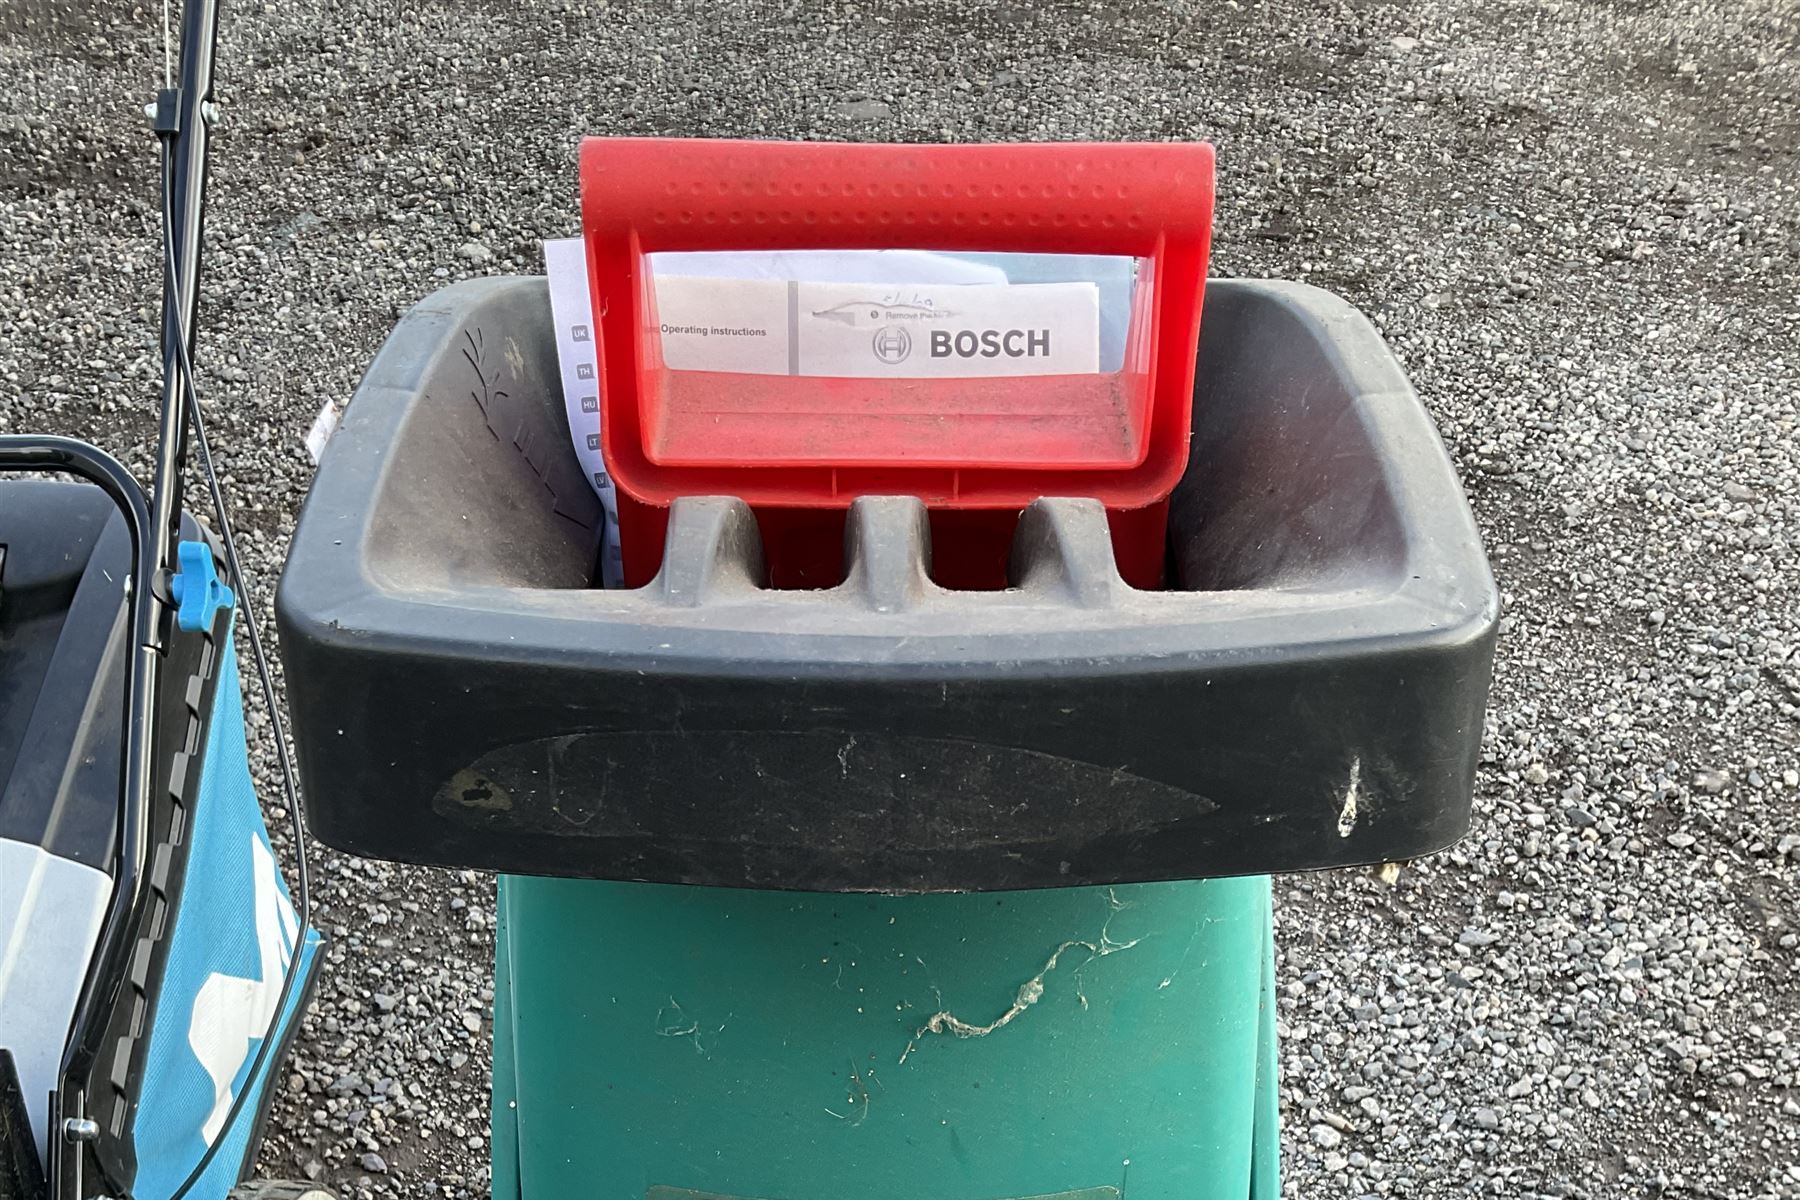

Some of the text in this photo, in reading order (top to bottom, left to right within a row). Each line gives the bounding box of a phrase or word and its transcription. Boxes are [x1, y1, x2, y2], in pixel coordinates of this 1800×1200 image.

[661, 324, 708, 336] Operating
[711, 326, 767, 337] instructions
[930, 329, 1050, 358] BOSCH
